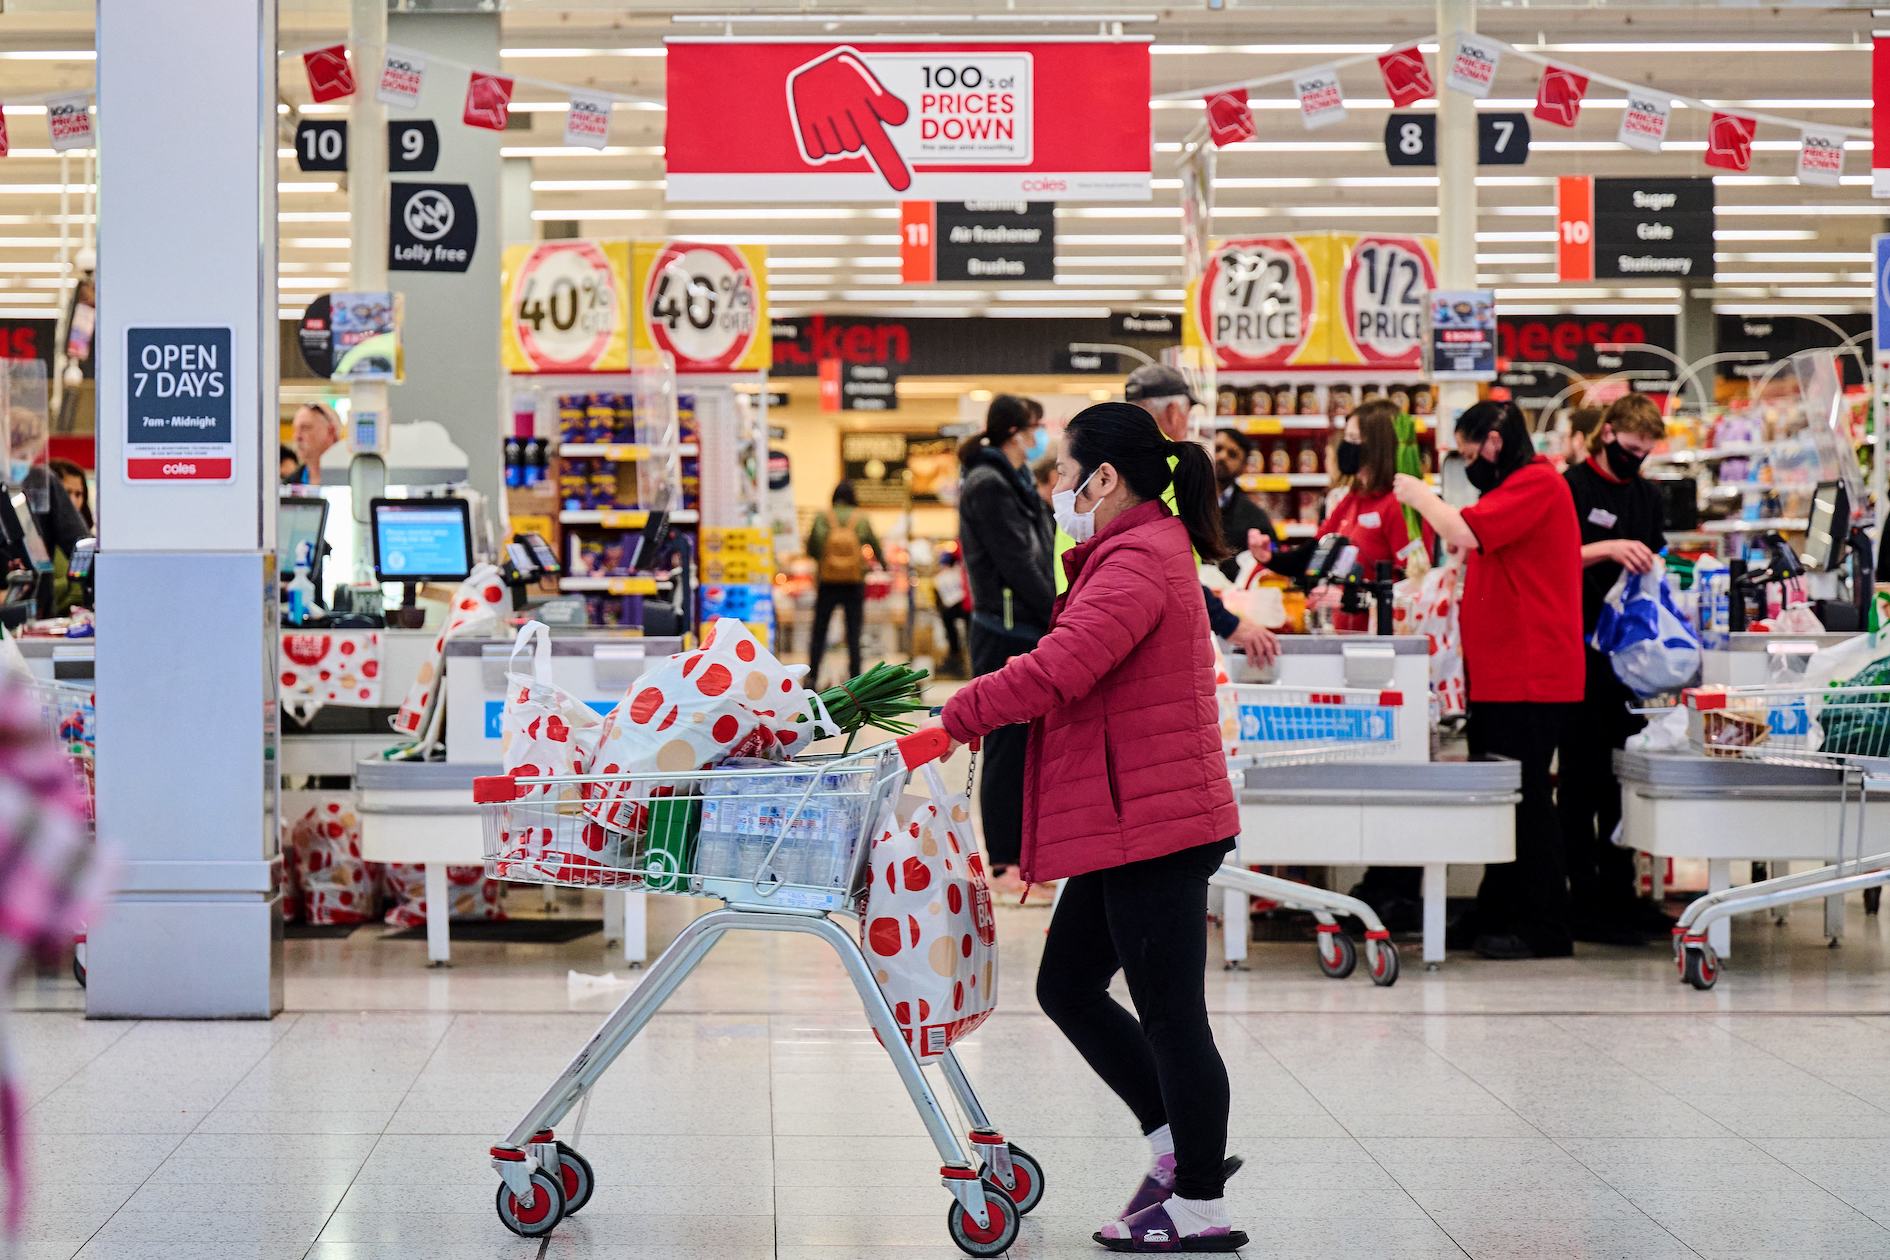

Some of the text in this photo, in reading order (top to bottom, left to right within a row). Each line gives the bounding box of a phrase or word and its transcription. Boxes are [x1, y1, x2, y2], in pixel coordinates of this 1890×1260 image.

[921, 93, 1014, 114] PRICES
[921, 118, 1014, 140] DOWN
[1399, 122, 1423, 155] 8
[1492, 121, 1515, 153] 7
[302, 129, 342, 161] 10
[401, 129, 424, 161] 9
[1022, 177, 1067, 192] coles
[1633, 190, 1677, 211] Sugar
[905, 223, 929, 247] 11
[1561, 220, 1589, 245] 10
[1636, 222, 1674, 240] Cake
[394, 245, 467, 265] Lolly free
[1362, 248, 1421, 306] 1/2
[1216, 311, 1297, 341] PRICE
[141, 344, 216, 371] OPEN
[133, 372, 225, 398] 7 DAYS
[143, 416, 164, 427] 7am
[171, 415, 216, 428] Midnight
[162, 462, 196, 475] coles
